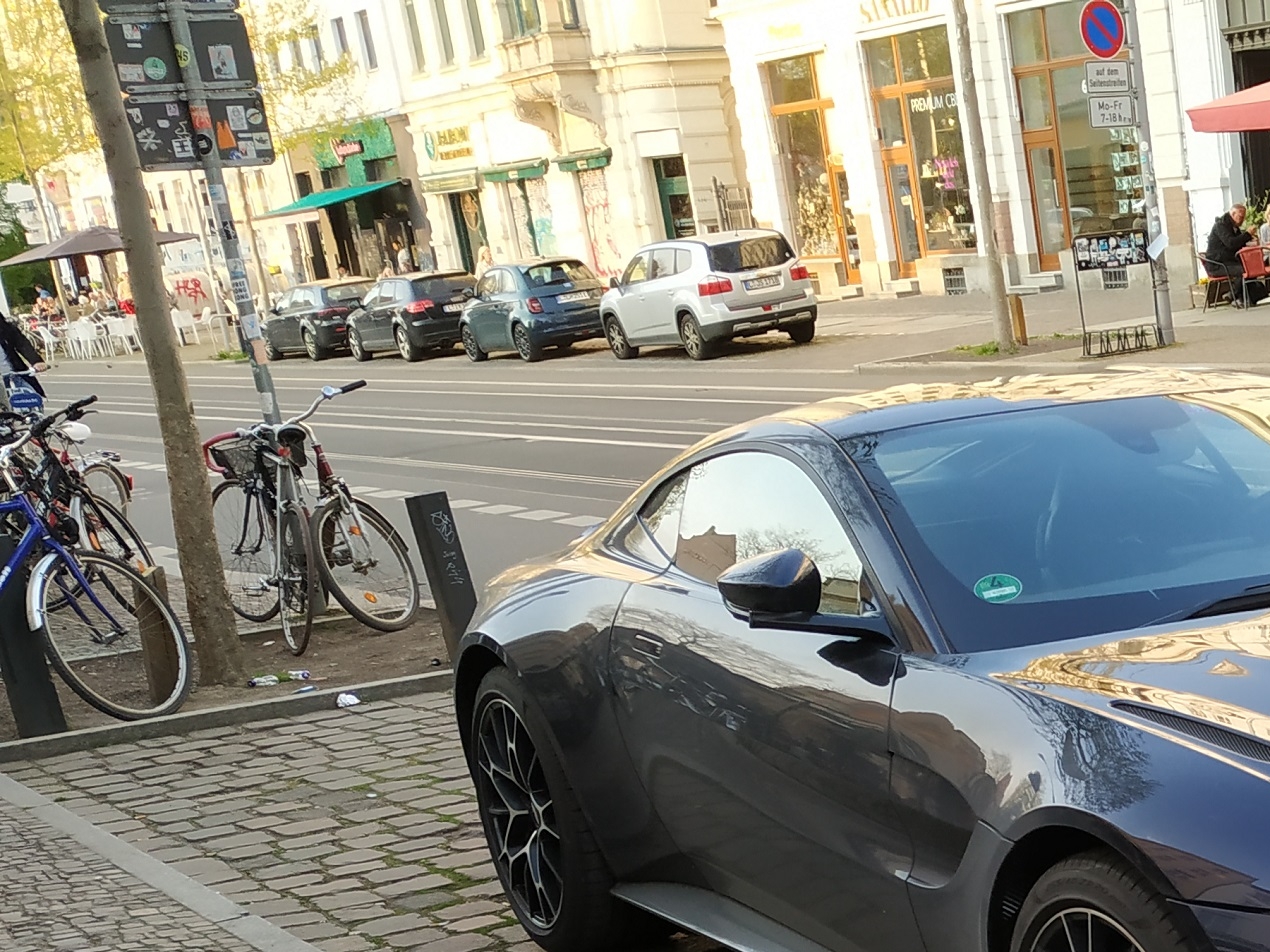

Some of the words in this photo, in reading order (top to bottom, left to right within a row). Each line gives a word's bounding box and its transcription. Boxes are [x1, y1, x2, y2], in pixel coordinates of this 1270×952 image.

[1095, 67, 1105, 76] auf
[1107, 67, 1119, 76] dem
[1089, 78, 1127, 88] Seitenstreifen
[910, 96, 944, 113] PREMIUM
[1097, 100, 1123, 111] Mo-Fr
[1100, 112, 1117, 123] 7-18
